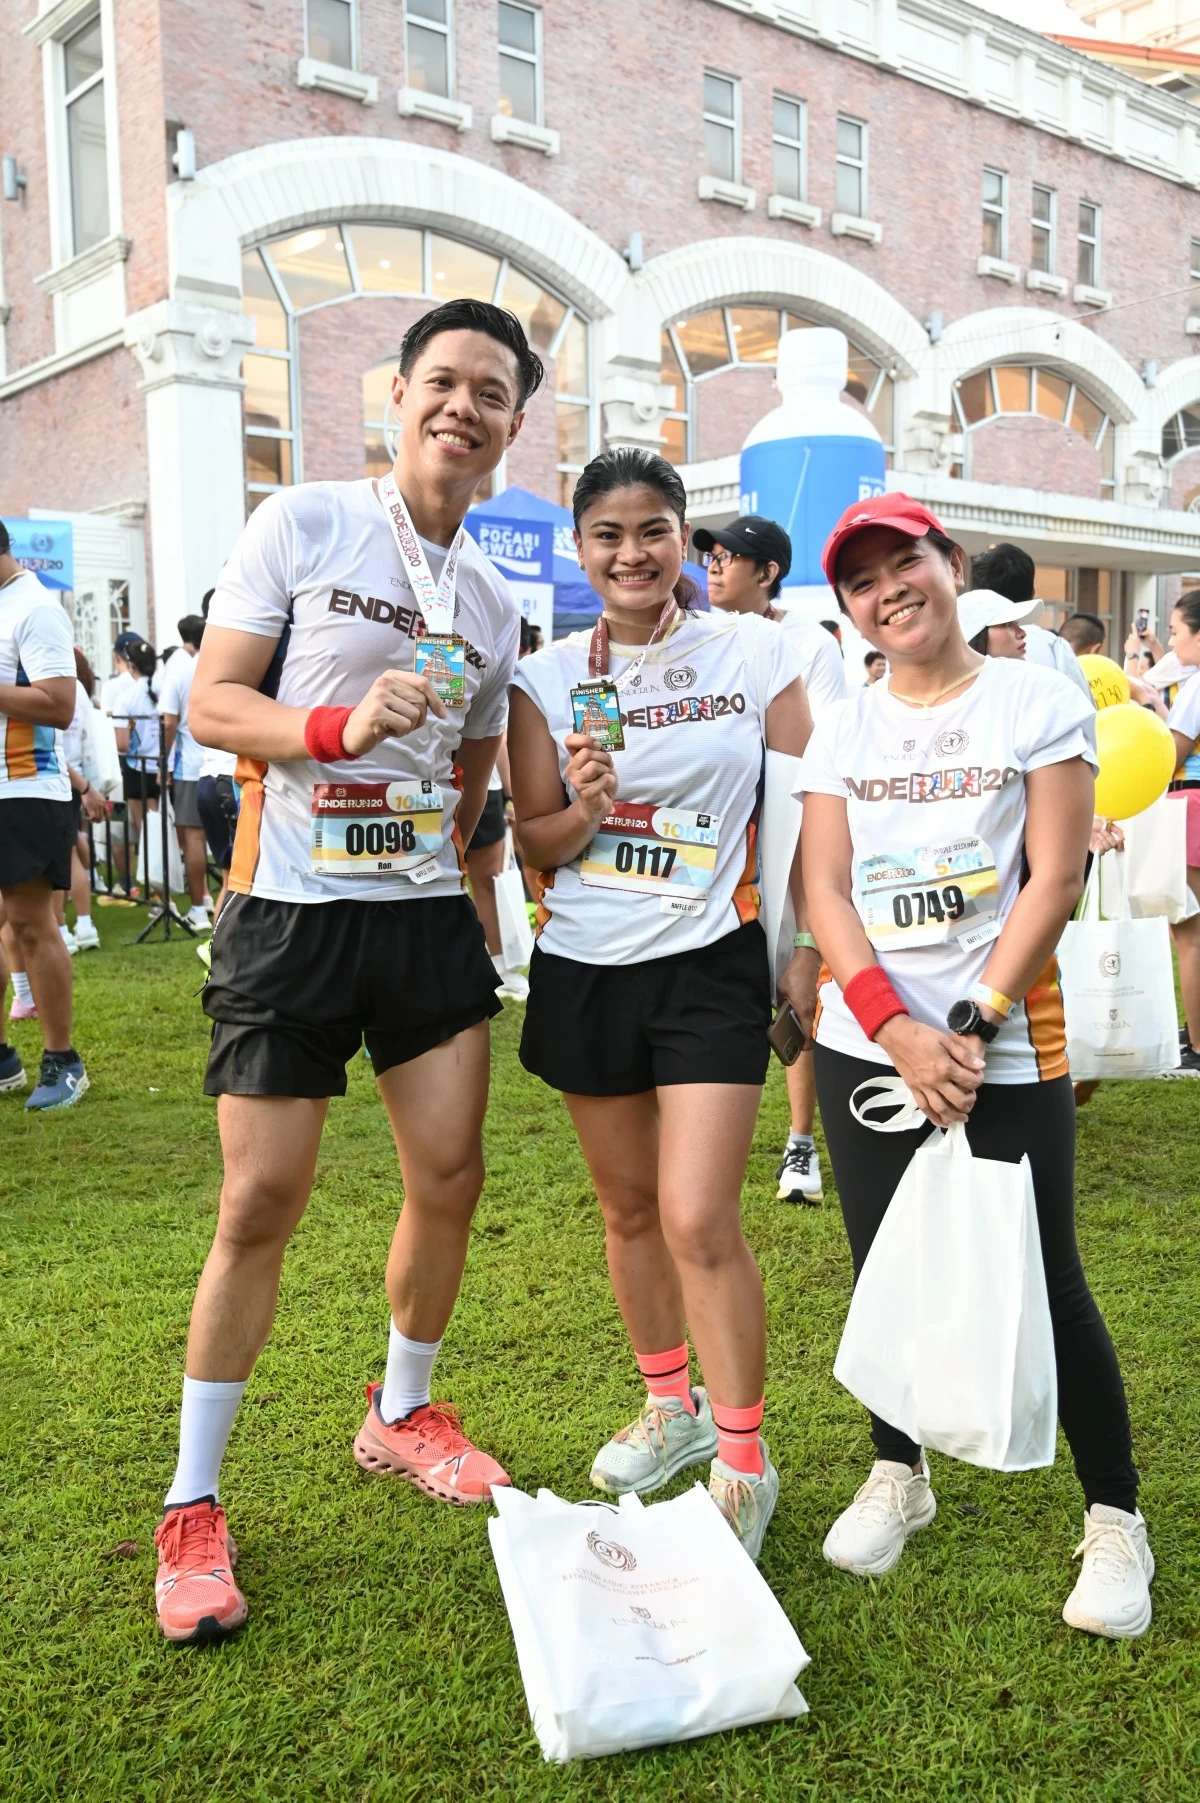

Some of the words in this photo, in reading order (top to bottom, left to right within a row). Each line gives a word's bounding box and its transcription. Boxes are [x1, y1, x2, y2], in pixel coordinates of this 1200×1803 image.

[480, 528, 539, 548] POCARI
[480, 541, 534, 559] SWEAT
[417, 638, 452, 646] FINISHER
[571, 687, 604, 696] FINISHER
[395, 793, 441, 810] 10KM
[345, 819, 416, 856] 0098
[662, 821, 717, 843] 10KM
[378, 862, 392, 870] Ron
[615, 841, 677, 878] 0117
[935, 850, 984, 876] 5KM
[670, 902, 688, 911] RAFFLE
[892, 885, 965, 928] 0749
[966, 934, 982, 945] RAFFLE
[599, 1545, 622, 1560] 20
